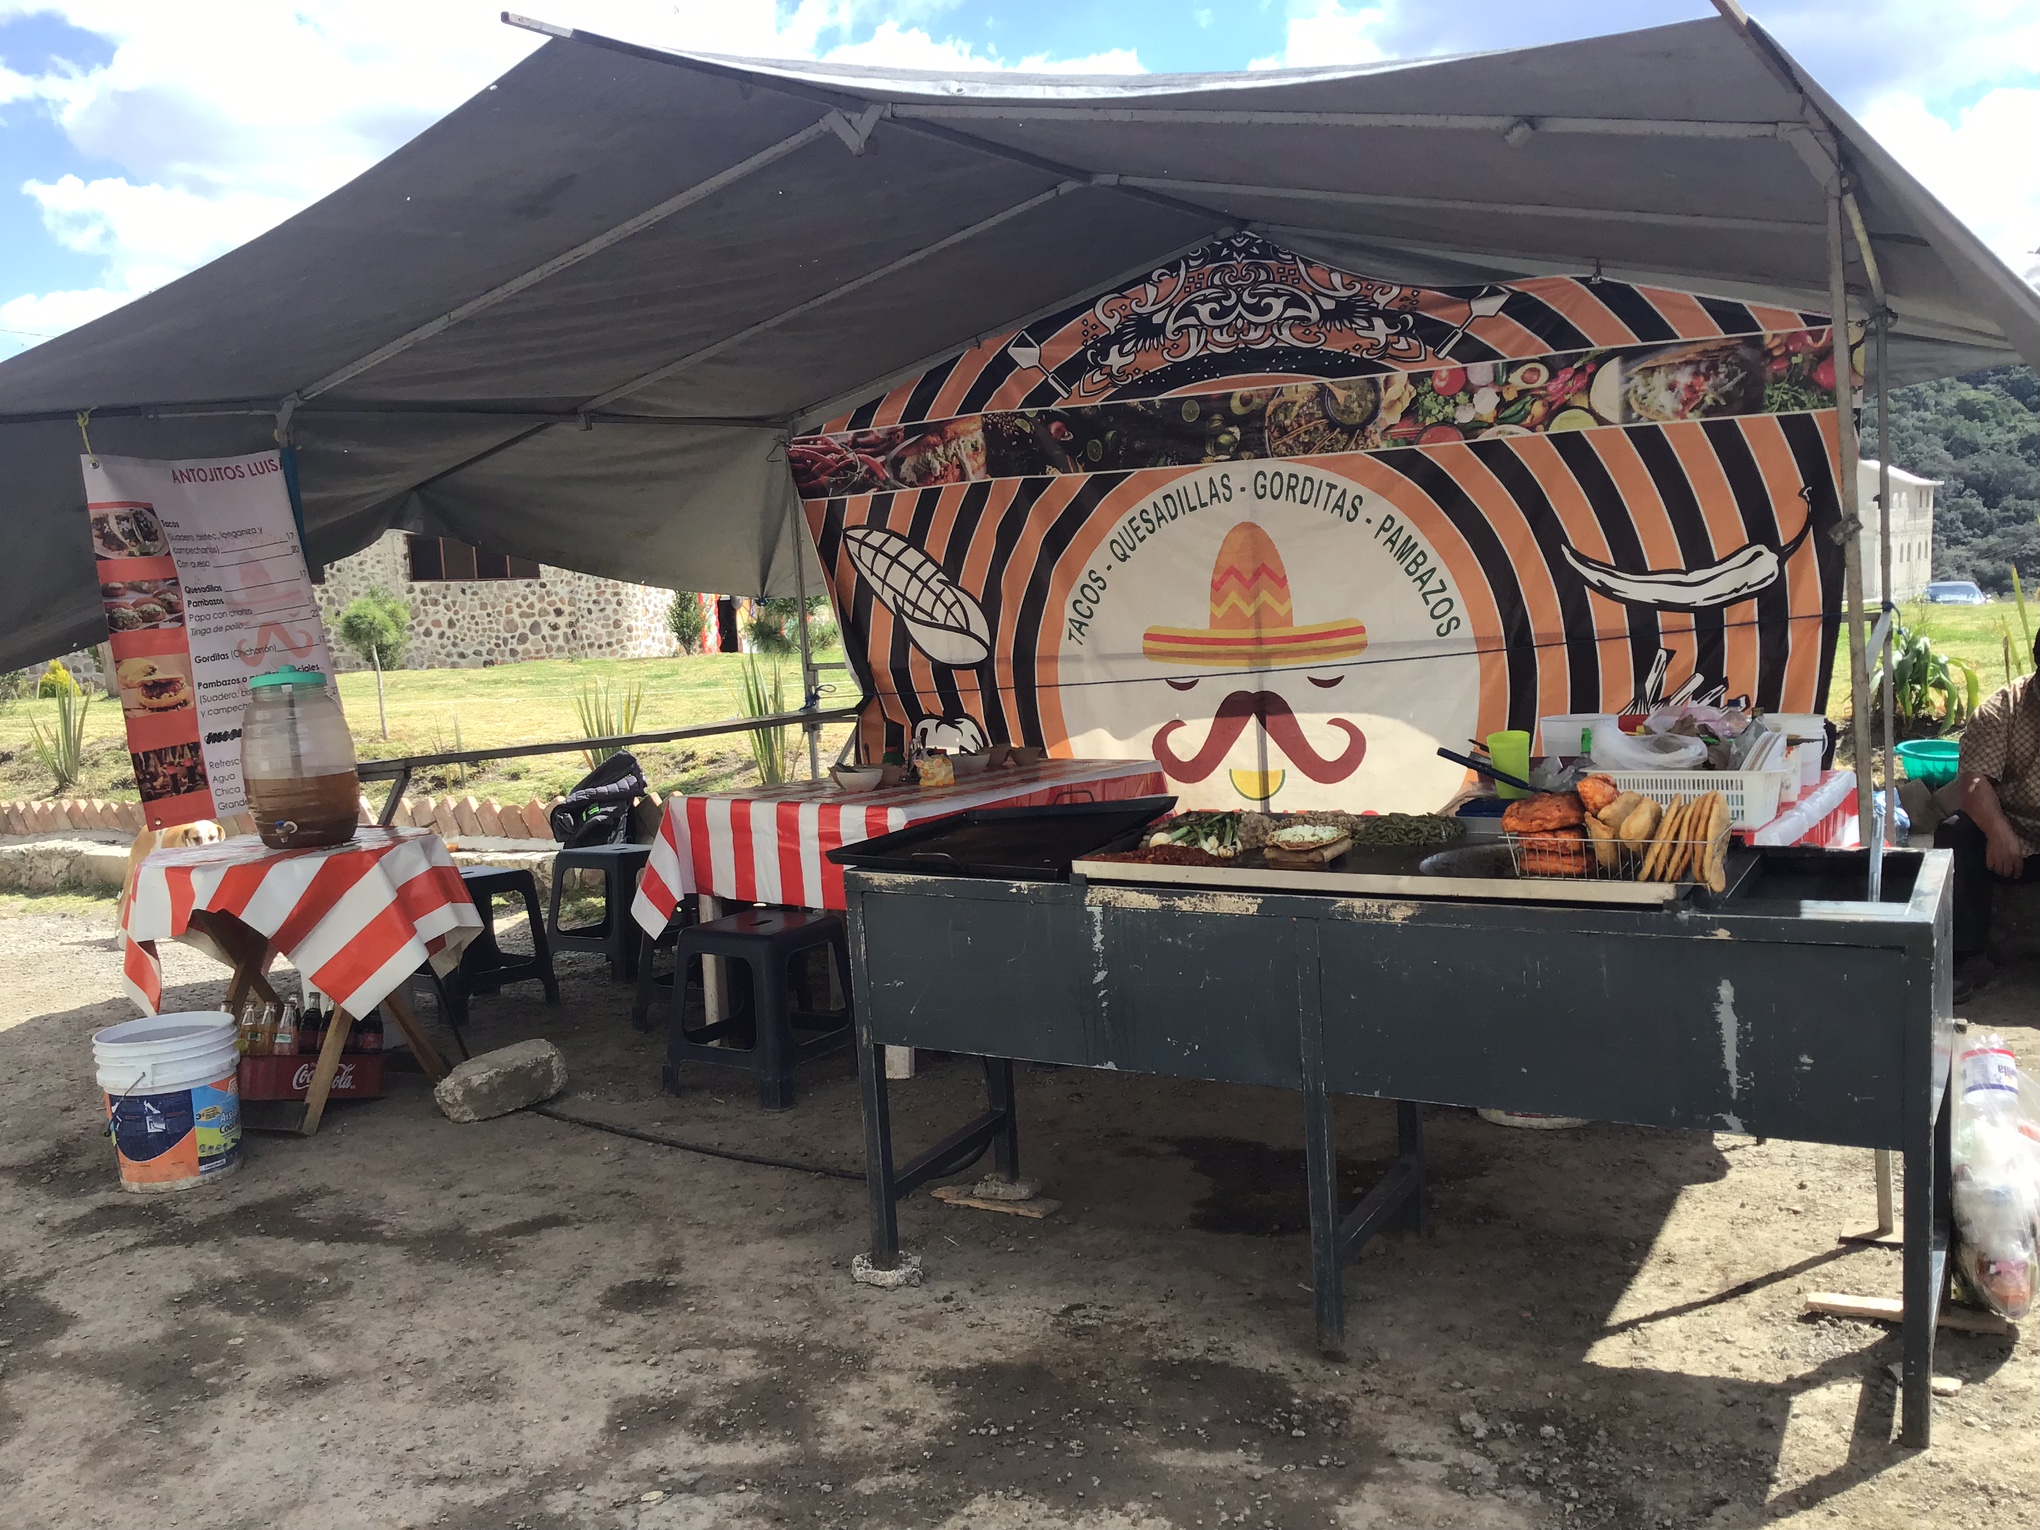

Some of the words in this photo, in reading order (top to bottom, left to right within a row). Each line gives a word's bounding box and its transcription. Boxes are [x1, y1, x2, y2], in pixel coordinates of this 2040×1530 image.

[171, 465, 245, 483] ANTOJITOS
[1067, 569, 1108, 646] TACOS
[1109, 473, 1233, 563] QUESADILLAS
[1254, 470, 1364, 523] GORDITAS
[1374, 513, 1461, 638] PAMBAZOS
[184, 584, 222, 594] Quesadillas
[187, 598, 224, 608] Pambazos
[189, 613, 211, 622] Papa
[213, 611, 227, 619] con
[190, 627, 212, 636] Tinga
[213, 625, 223, 633] de
[195, 652, 229, 664] Gorditas
[197, 677, 240, 690] Pambazos
[209, 758, 241, 770] Refresc
[212, 772, 236, 784] Agua
[214, 786, 241, 797] Chica
